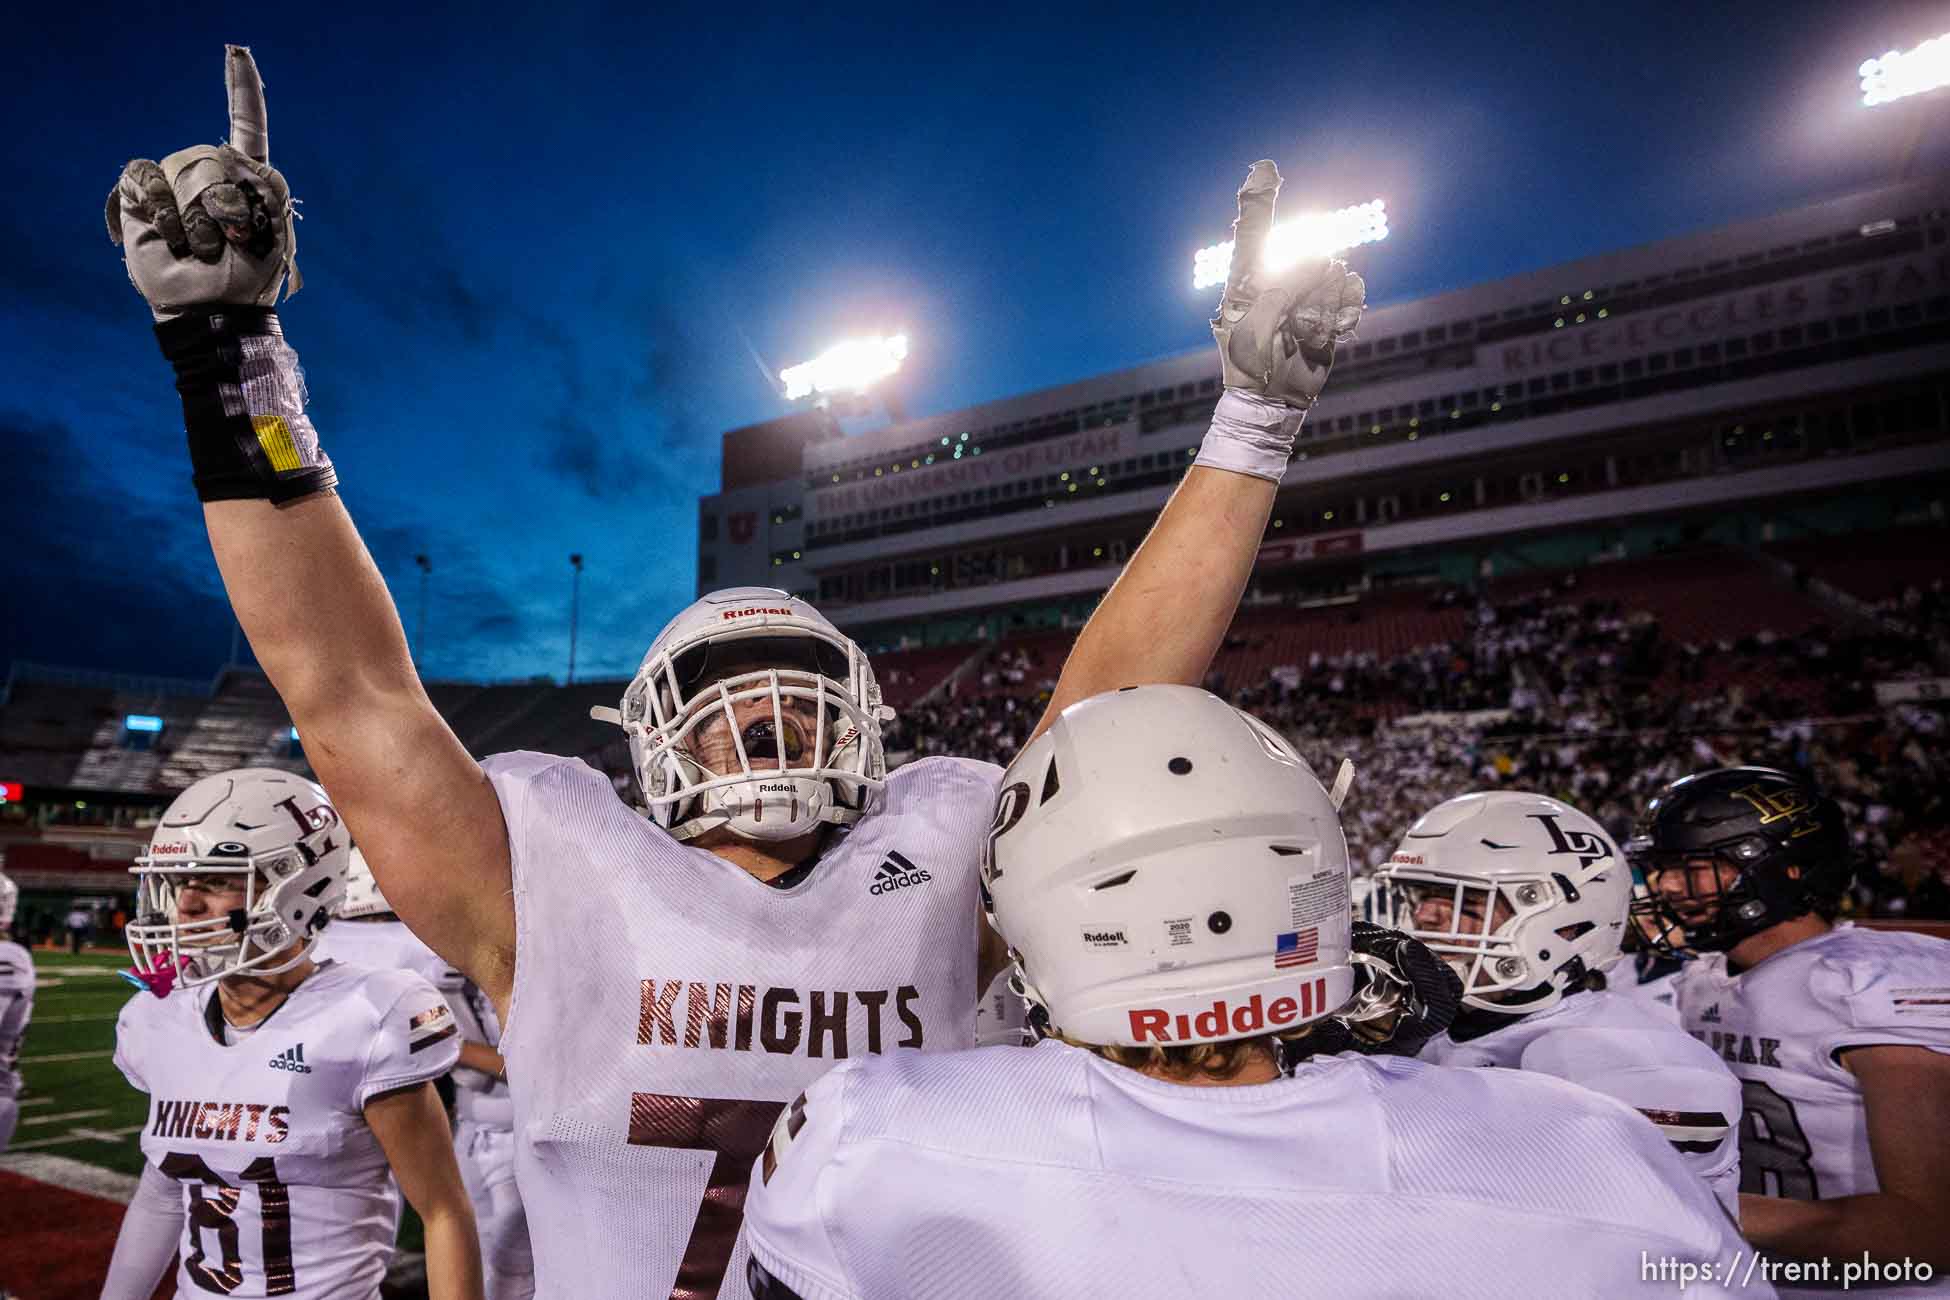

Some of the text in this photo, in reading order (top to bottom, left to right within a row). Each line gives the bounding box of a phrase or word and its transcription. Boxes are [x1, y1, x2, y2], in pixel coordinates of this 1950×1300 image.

[870, 870, 932, 896] adidas
[637, 979, 924, 1059] KNIGHTS
[1128, 978, 1326, 1042] Riddell
[269, 1056, 312, 1074] adidas
[152, 1101, 290, 1143] KNIGHTS
